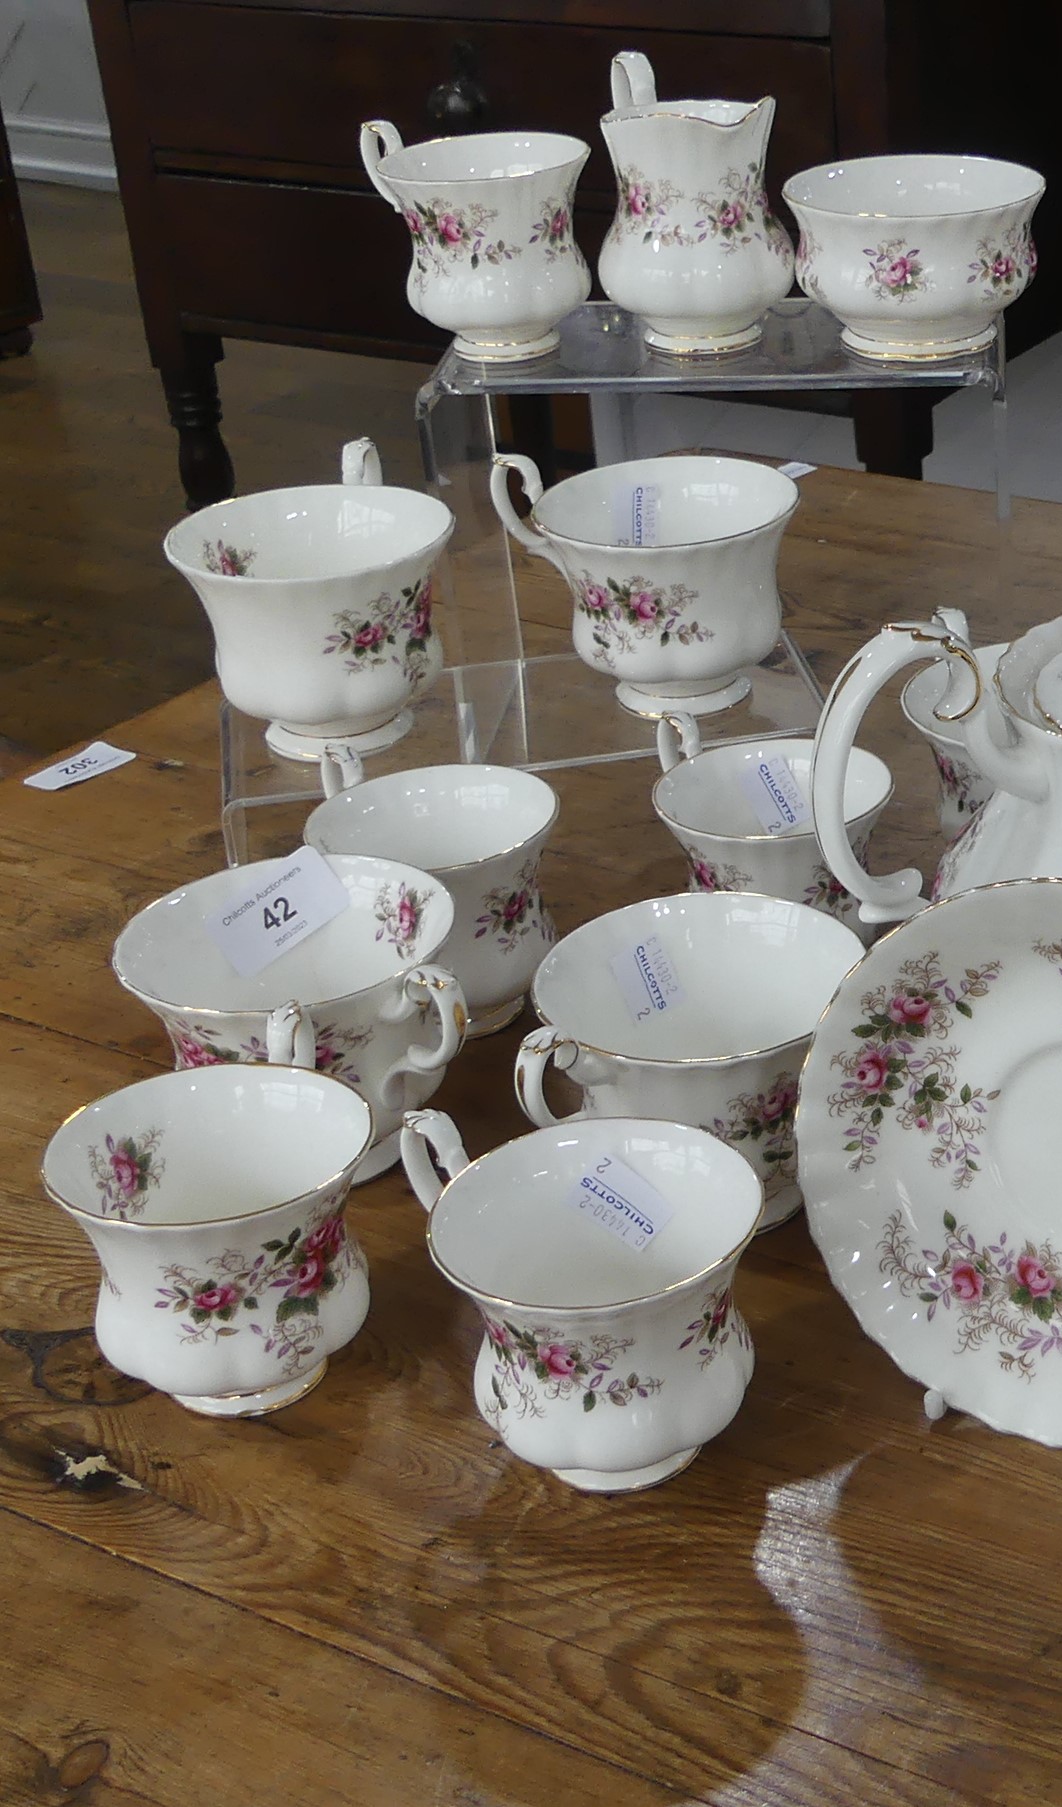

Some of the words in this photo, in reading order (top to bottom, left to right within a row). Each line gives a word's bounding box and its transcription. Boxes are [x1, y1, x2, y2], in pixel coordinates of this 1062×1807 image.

[59, 758, 98, 775] 302
[760, 764, 797, 824] CHILCOTTS
[767, 821, 782, 833] 2
[222, 899, 256, 927] Chilcotts
[256, 866, 302, 902] Auctioneers
[263, 896, 298, 930] 42
[636, 945, 667, 1010] CHILCOTTS
[637, 1007, 651, 1021] 2
[596, 1157, 612, 1174] 2
[580, 1176, 654, 1235] CHILCOTTS
